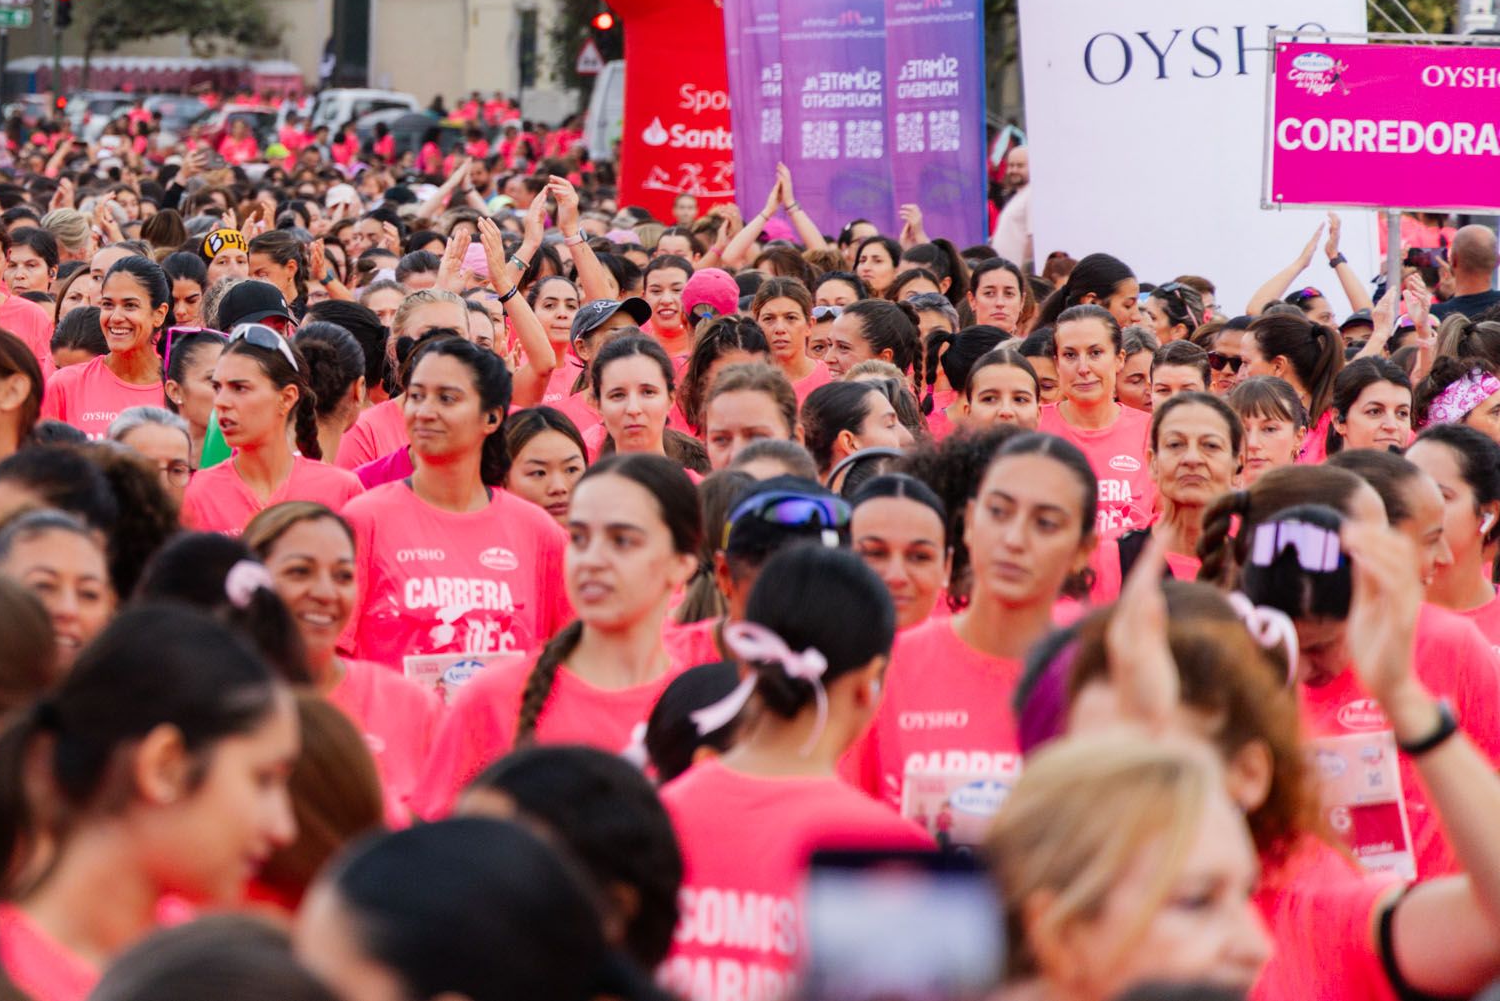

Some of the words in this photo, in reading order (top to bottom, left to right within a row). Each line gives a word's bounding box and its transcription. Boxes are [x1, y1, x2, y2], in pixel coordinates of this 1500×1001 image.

[1277, 117, 1500, 156] CORREDORA
[82, 411, 118, 422] OYSHO
[396, 549, 445, 562] OYSHO
[404, 577, 515, 613] CARRERA
[898, 710, 969, 730] OYSHO
